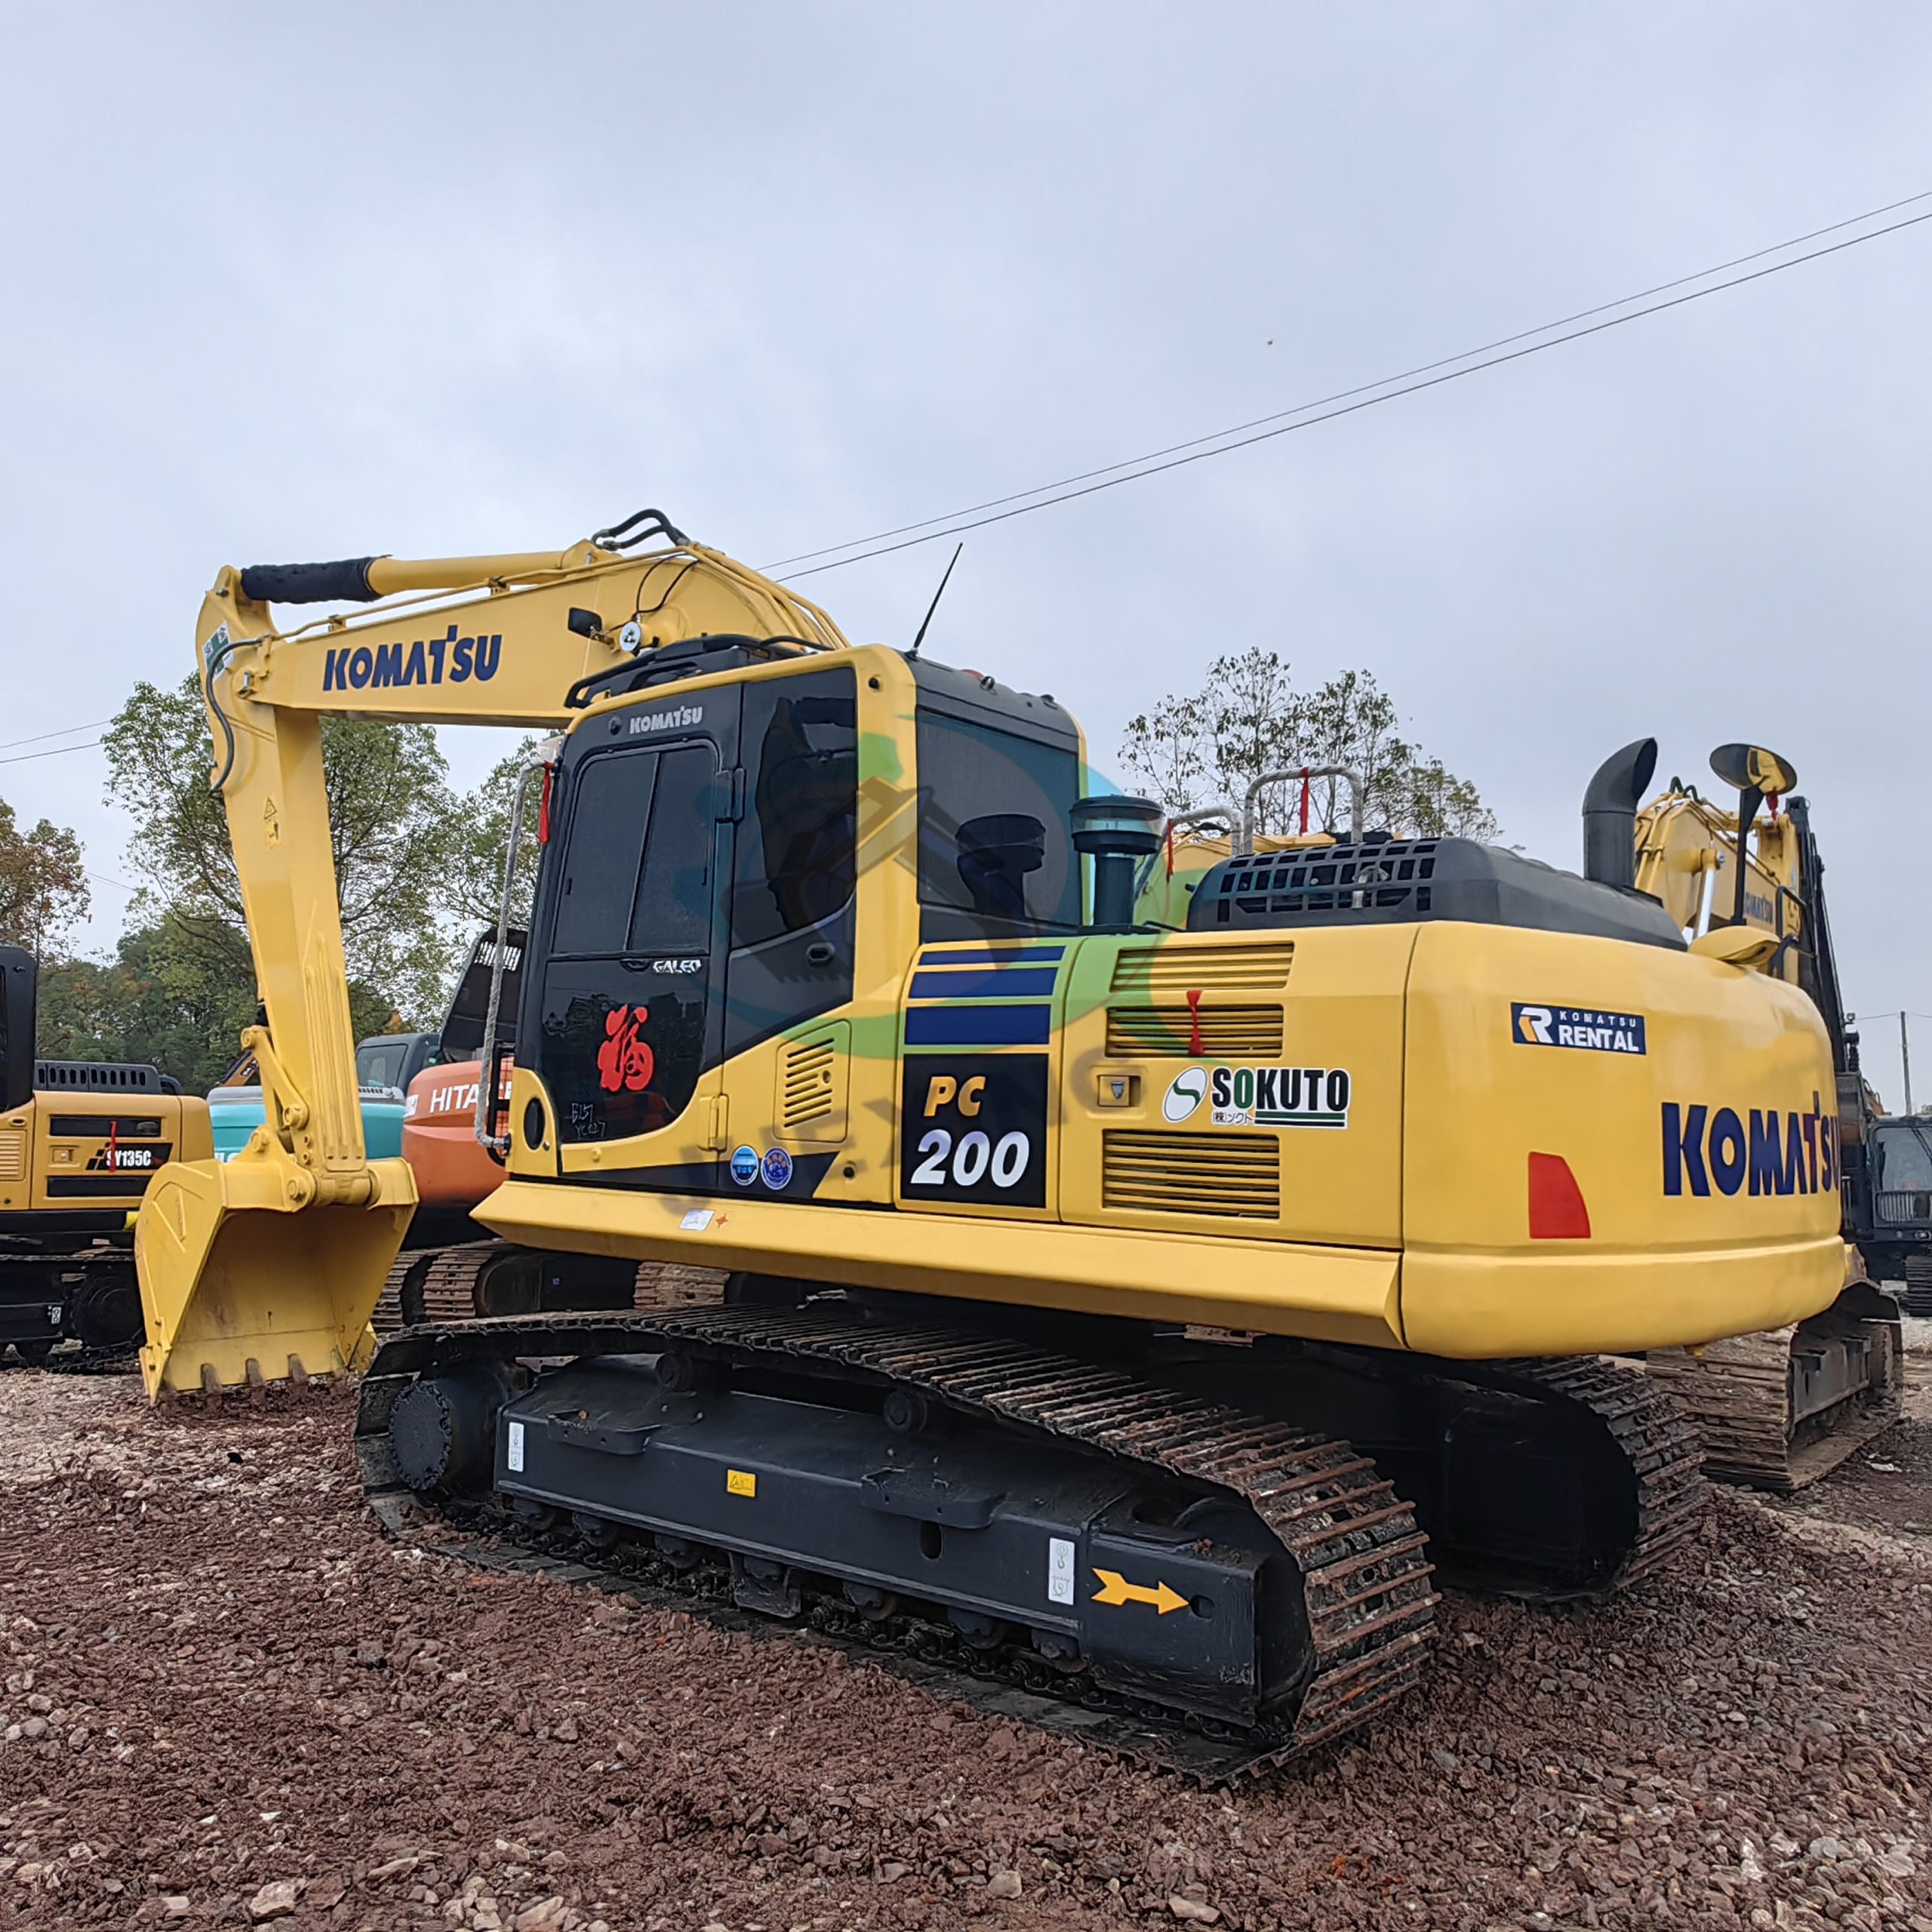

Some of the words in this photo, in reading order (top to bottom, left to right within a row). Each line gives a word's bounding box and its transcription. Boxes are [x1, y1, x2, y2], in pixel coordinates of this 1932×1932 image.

[322, 624, 503, 692] KOMATSU
[629, 705, 703, 735] KOMATSU
[652, 958, 702, 974] GALEO
[1558, 1024, 1640, 1052] RENTAL
[1559, 1010, 1637, 1028] KOMATSU
[923, 1075, 986, 1117] PC
[1211, 1067, 1349, 1112] SOKUTO
[910, 1128, 1030, 1188] 200
[1661, 1091, 1839, 1197] KOMATSU
